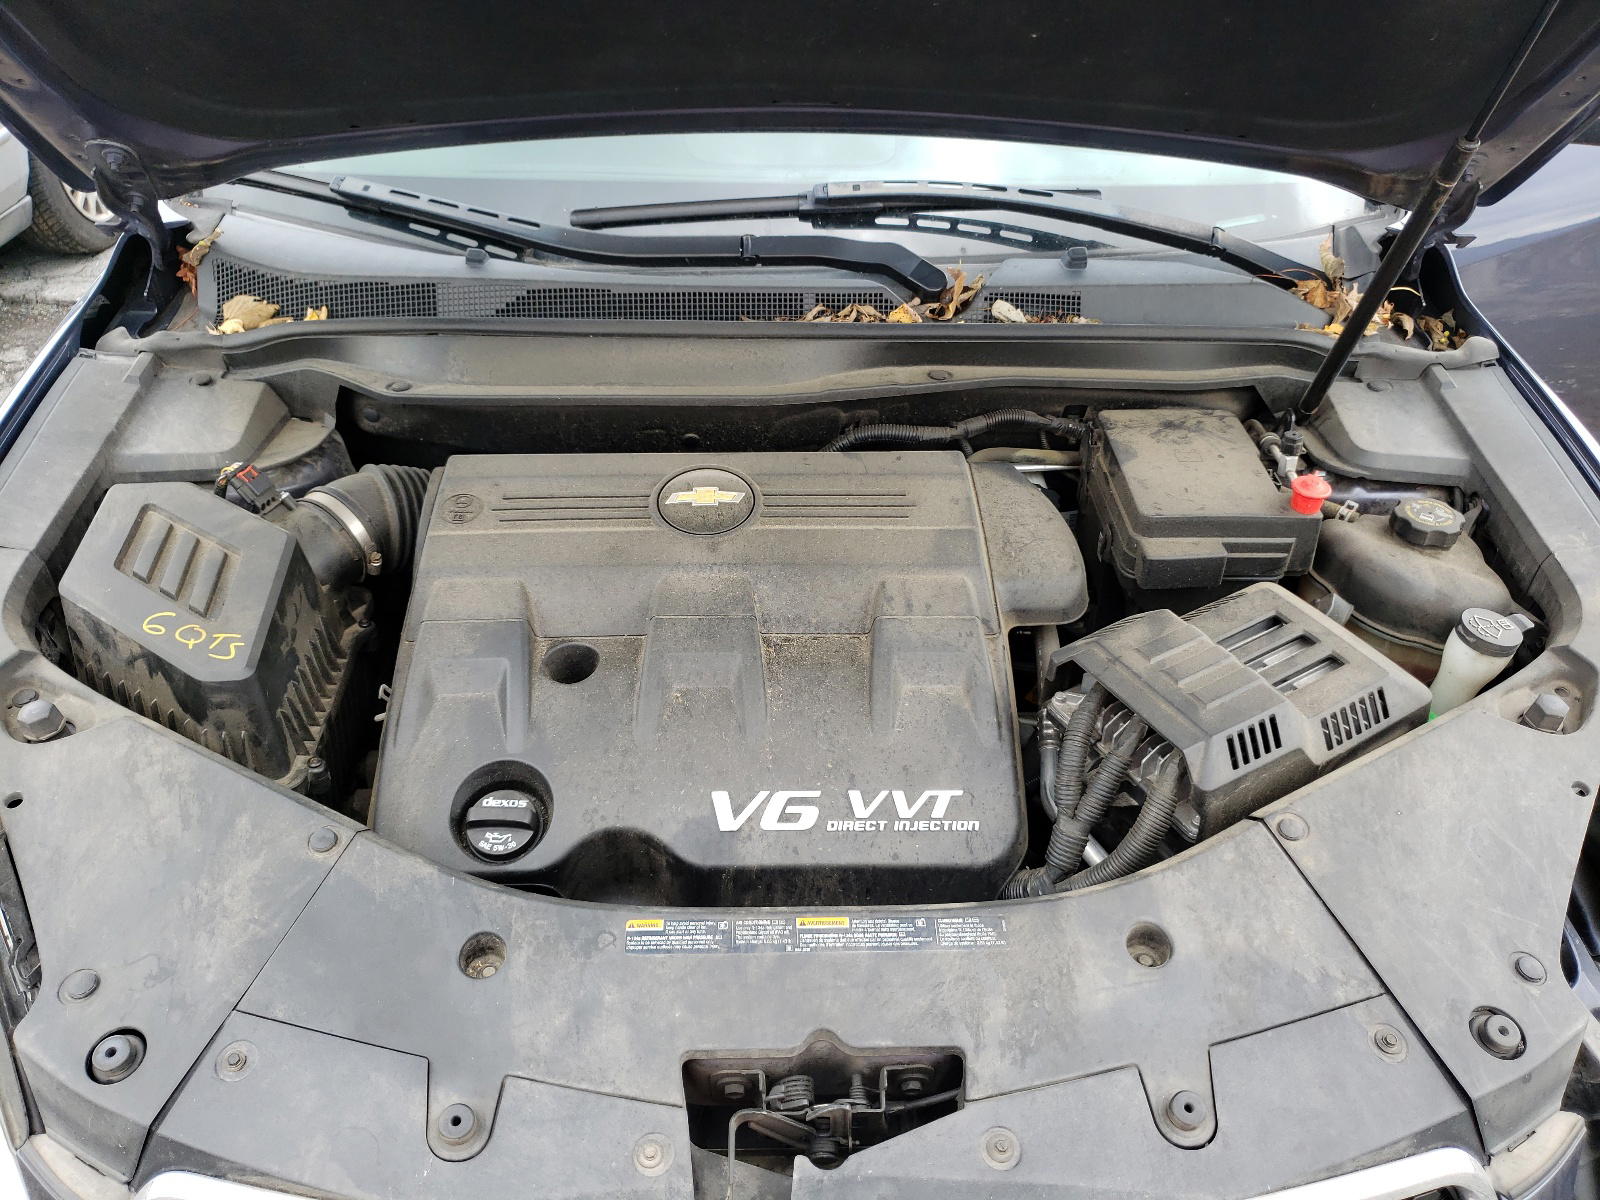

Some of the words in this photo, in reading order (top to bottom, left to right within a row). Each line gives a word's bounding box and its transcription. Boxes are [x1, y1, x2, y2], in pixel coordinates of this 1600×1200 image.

[142, 611, 177, 635] 6
[482, 797, 529, 808] dexos
[710, 789, 821, 832] V6
[847, 789, 964, 819] VVT
[826, 820, 888, 832] DIRECT
[893, 819, 980, 832] INJECTION
[478, 840, 491, 851] SAE
[492, 841, 517, 852] 5W-30
